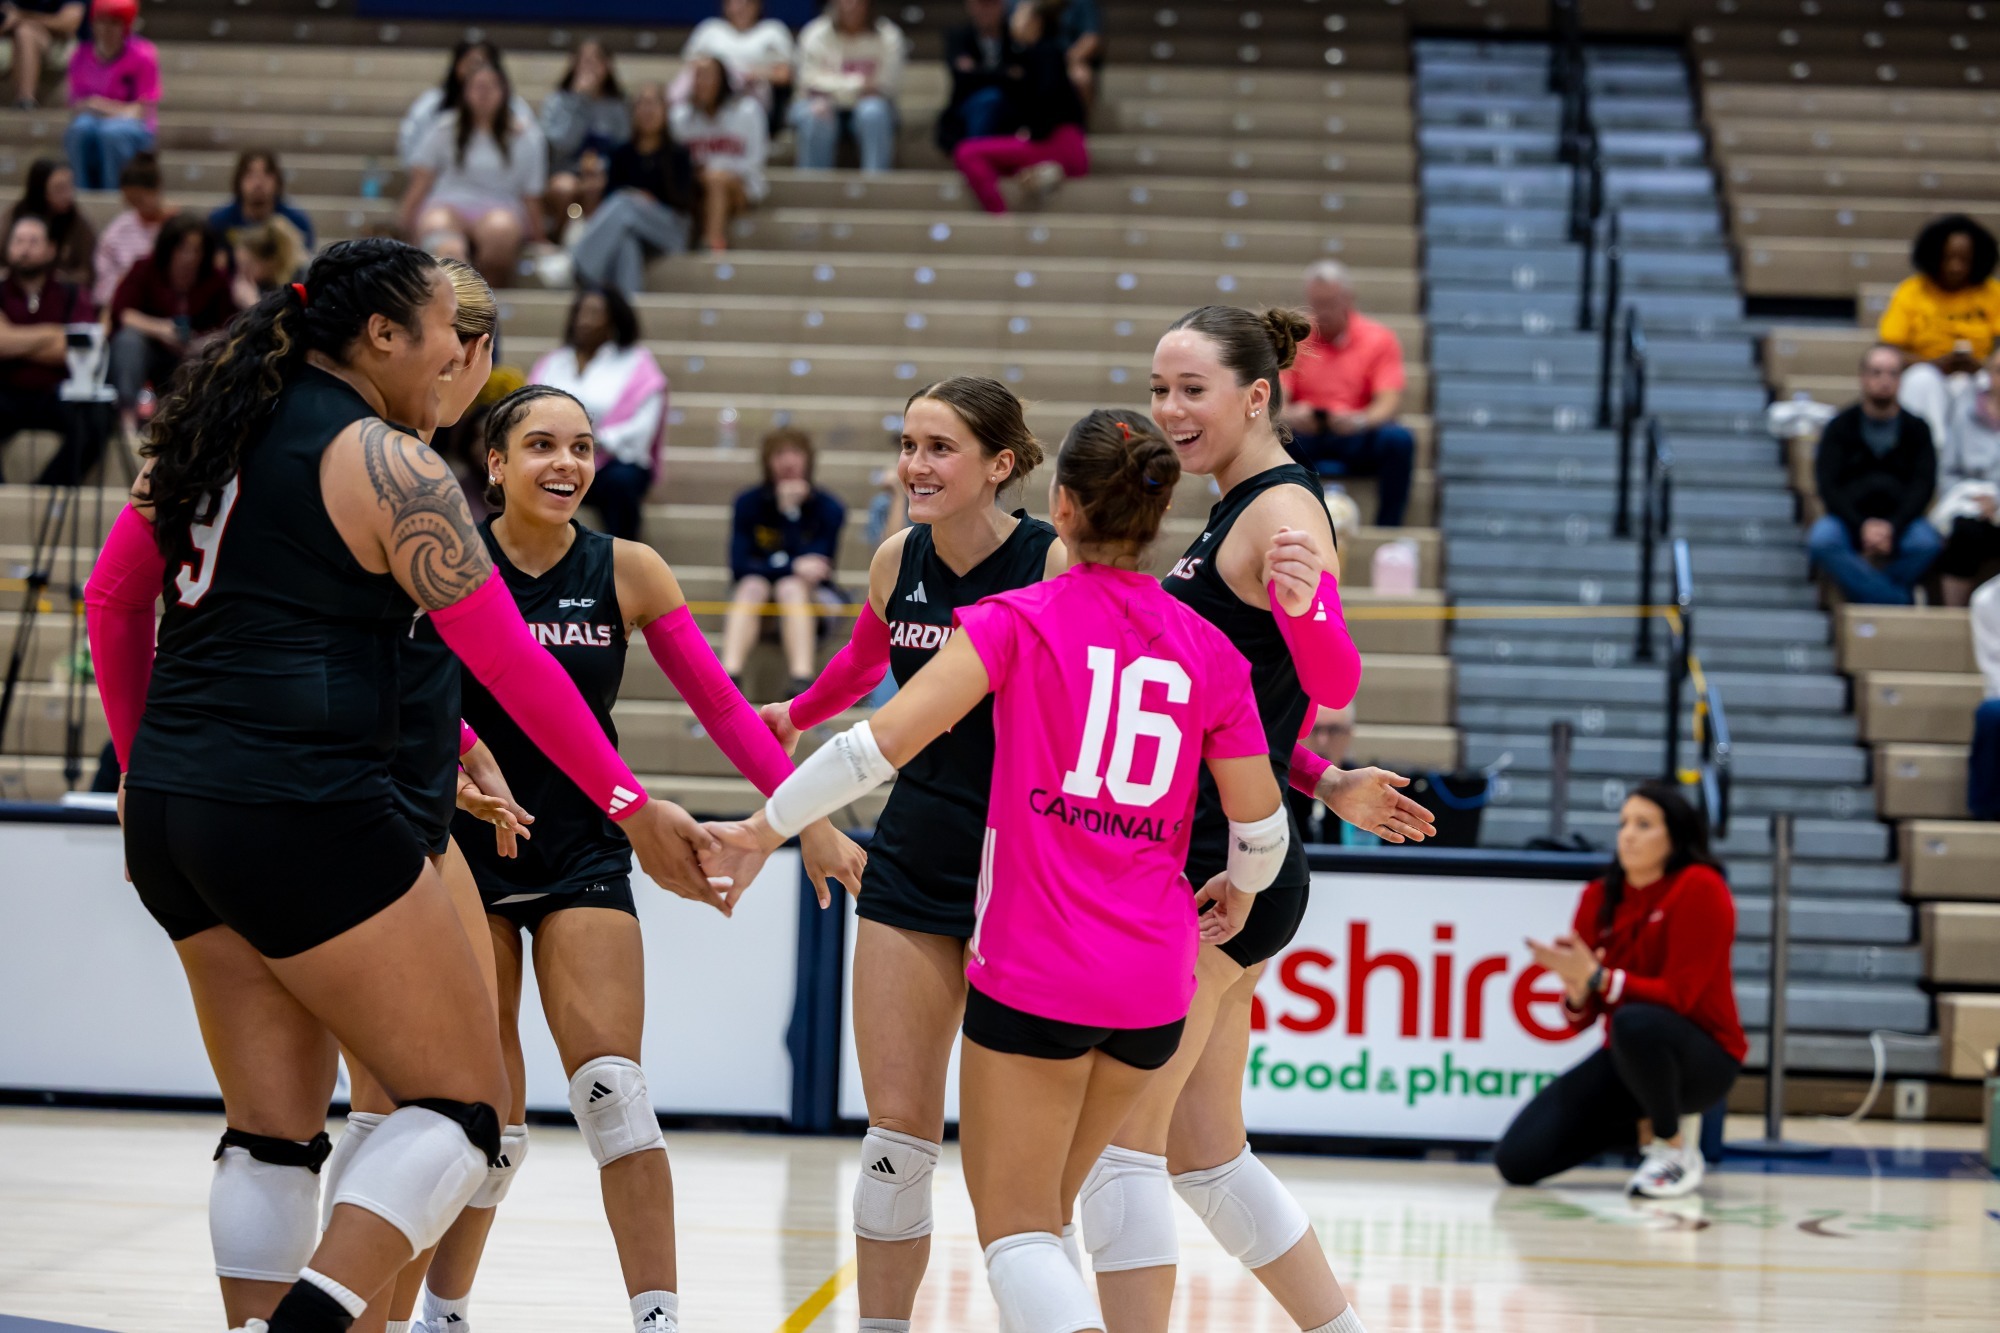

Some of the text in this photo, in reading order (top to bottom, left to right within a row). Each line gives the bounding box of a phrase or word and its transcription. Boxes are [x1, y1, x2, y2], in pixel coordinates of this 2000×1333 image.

[889, 620, 955, 650] CARDI
[1061, 645, 1192, 808] 16
[1249, 919, 1580, 1042] shire
